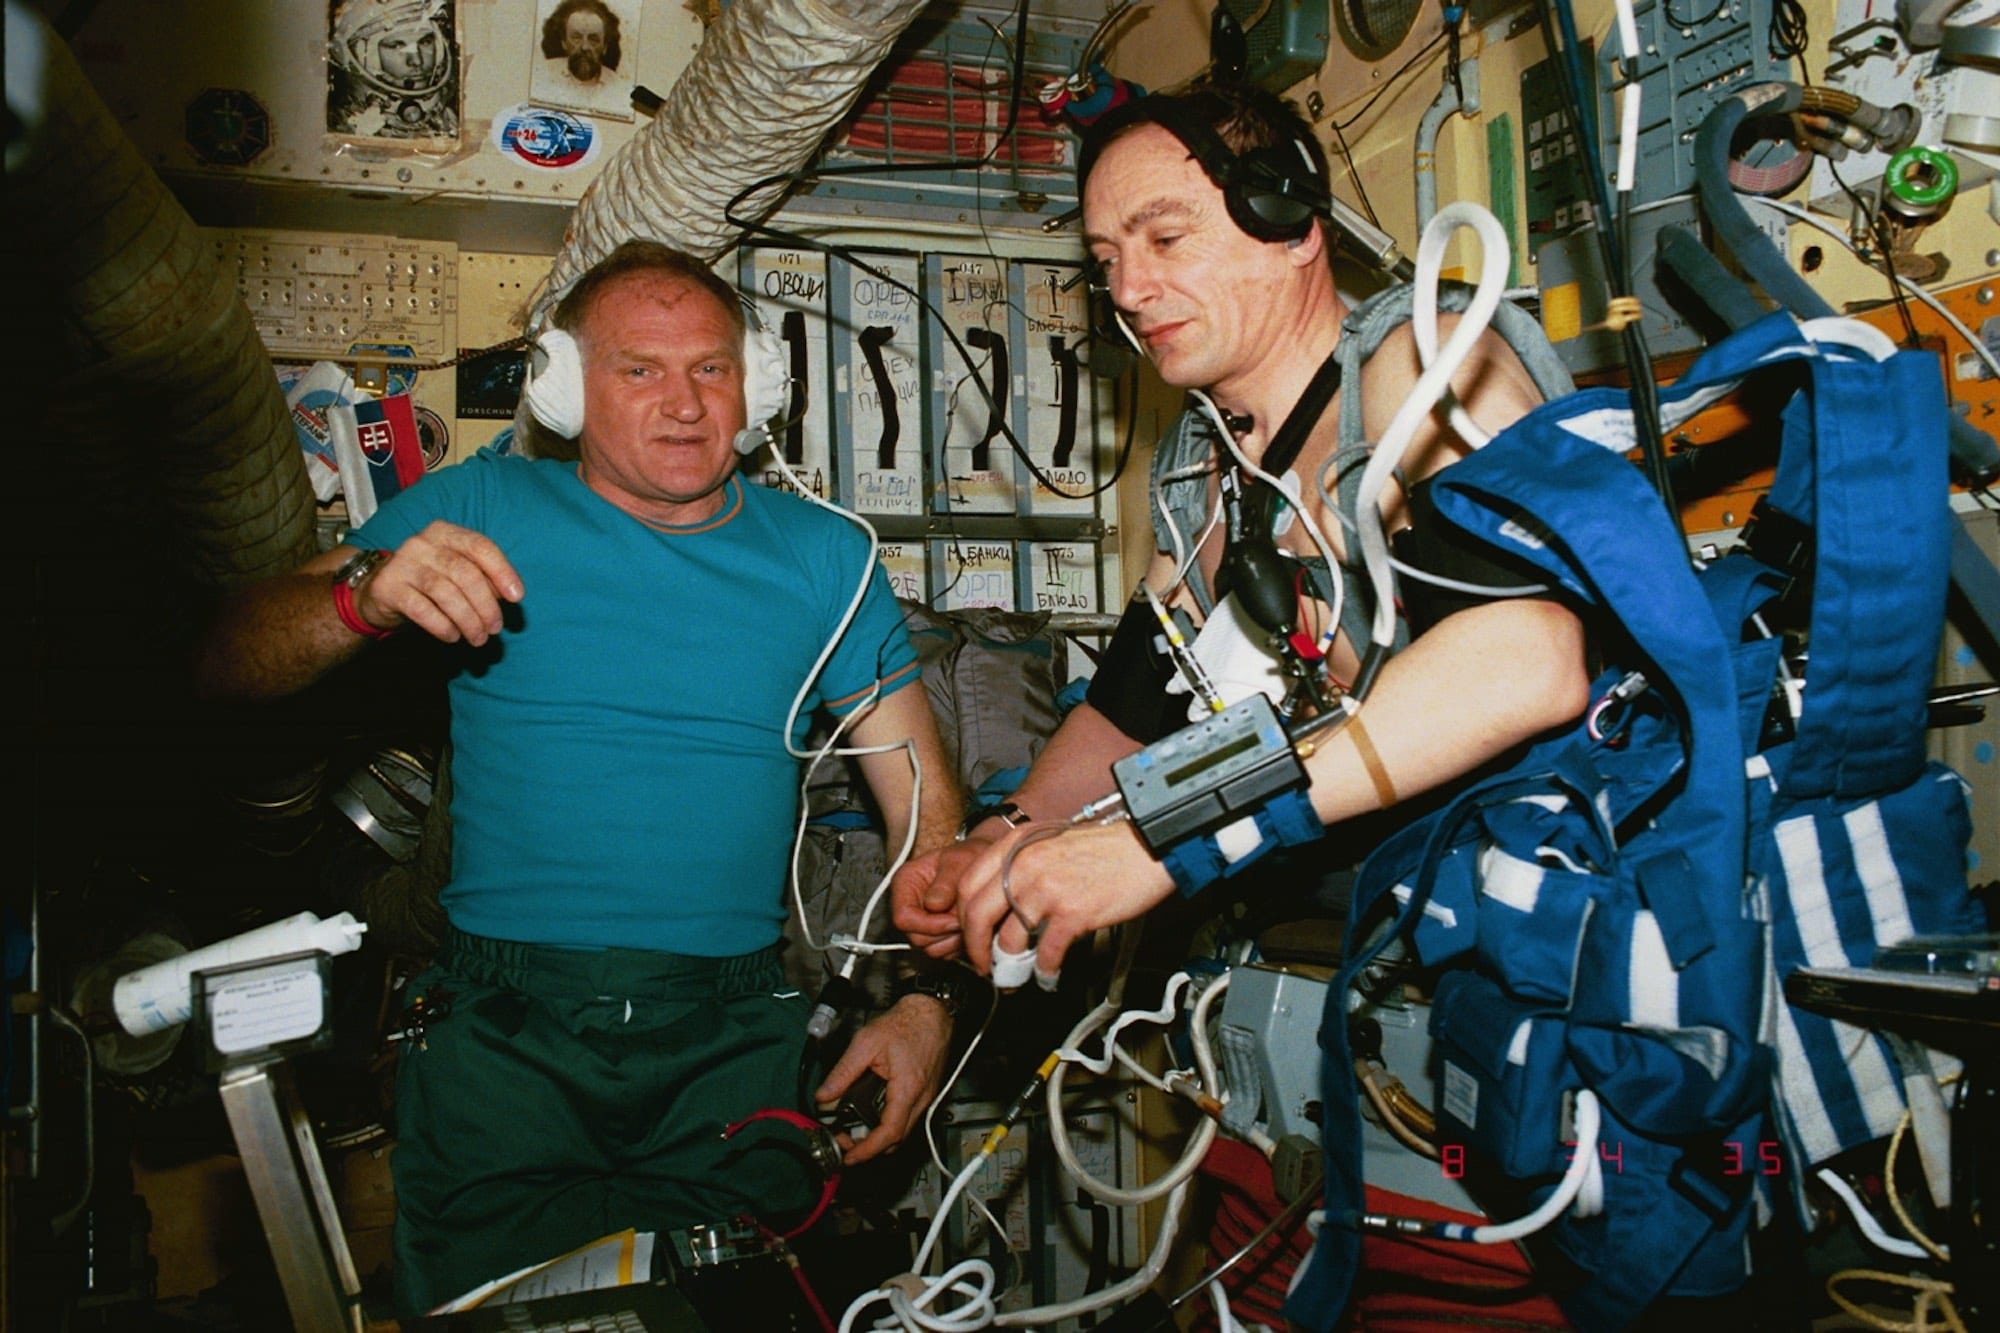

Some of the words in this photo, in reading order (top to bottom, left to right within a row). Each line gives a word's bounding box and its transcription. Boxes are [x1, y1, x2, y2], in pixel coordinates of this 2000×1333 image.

[779, 253, 800, 265] 071
[960, 264, 982, 276] 047
[879, 546, 902, 558] 957
[1036, 593, 1088, 609] БЛЮДО
